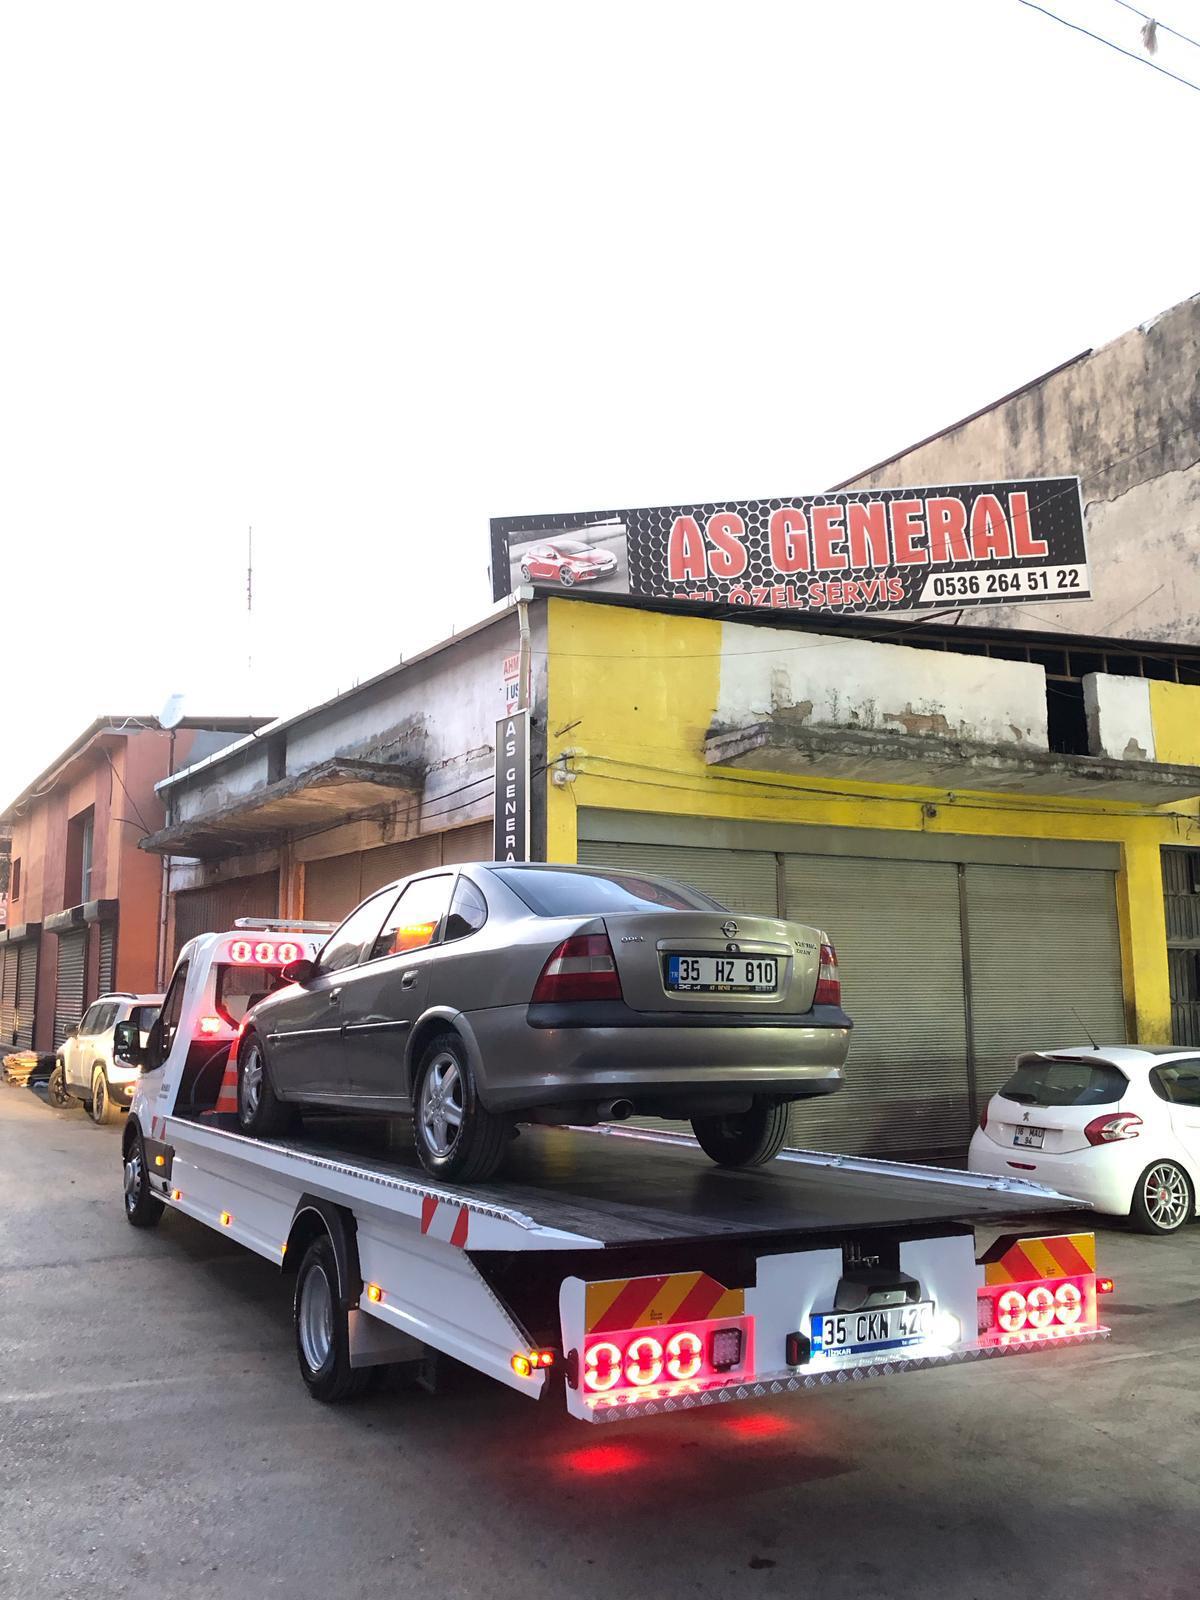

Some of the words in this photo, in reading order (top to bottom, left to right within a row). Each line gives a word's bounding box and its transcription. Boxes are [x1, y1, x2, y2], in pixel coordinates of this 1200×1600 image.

[667, 512, 748, 582] AS
[769, 491, 1048, 573] GENERAL
[728, 584, 804, 609] ÖZEL
[808, 574, 905, 606] SERVİS
[933, 576, 980, 597] 0536
[986, 573, 1021, 593] 264
[1027, 571, 1048, 590] 51
[1057, 569, 1080, 589] 22
[680, 959, 700, 981] 35
[715, 961, 735, 982] HZ
[745, 962, 773, 983] 810
[824, 1318, 847, 1346] 35
[856, 1312, 889, 1342] CKN
